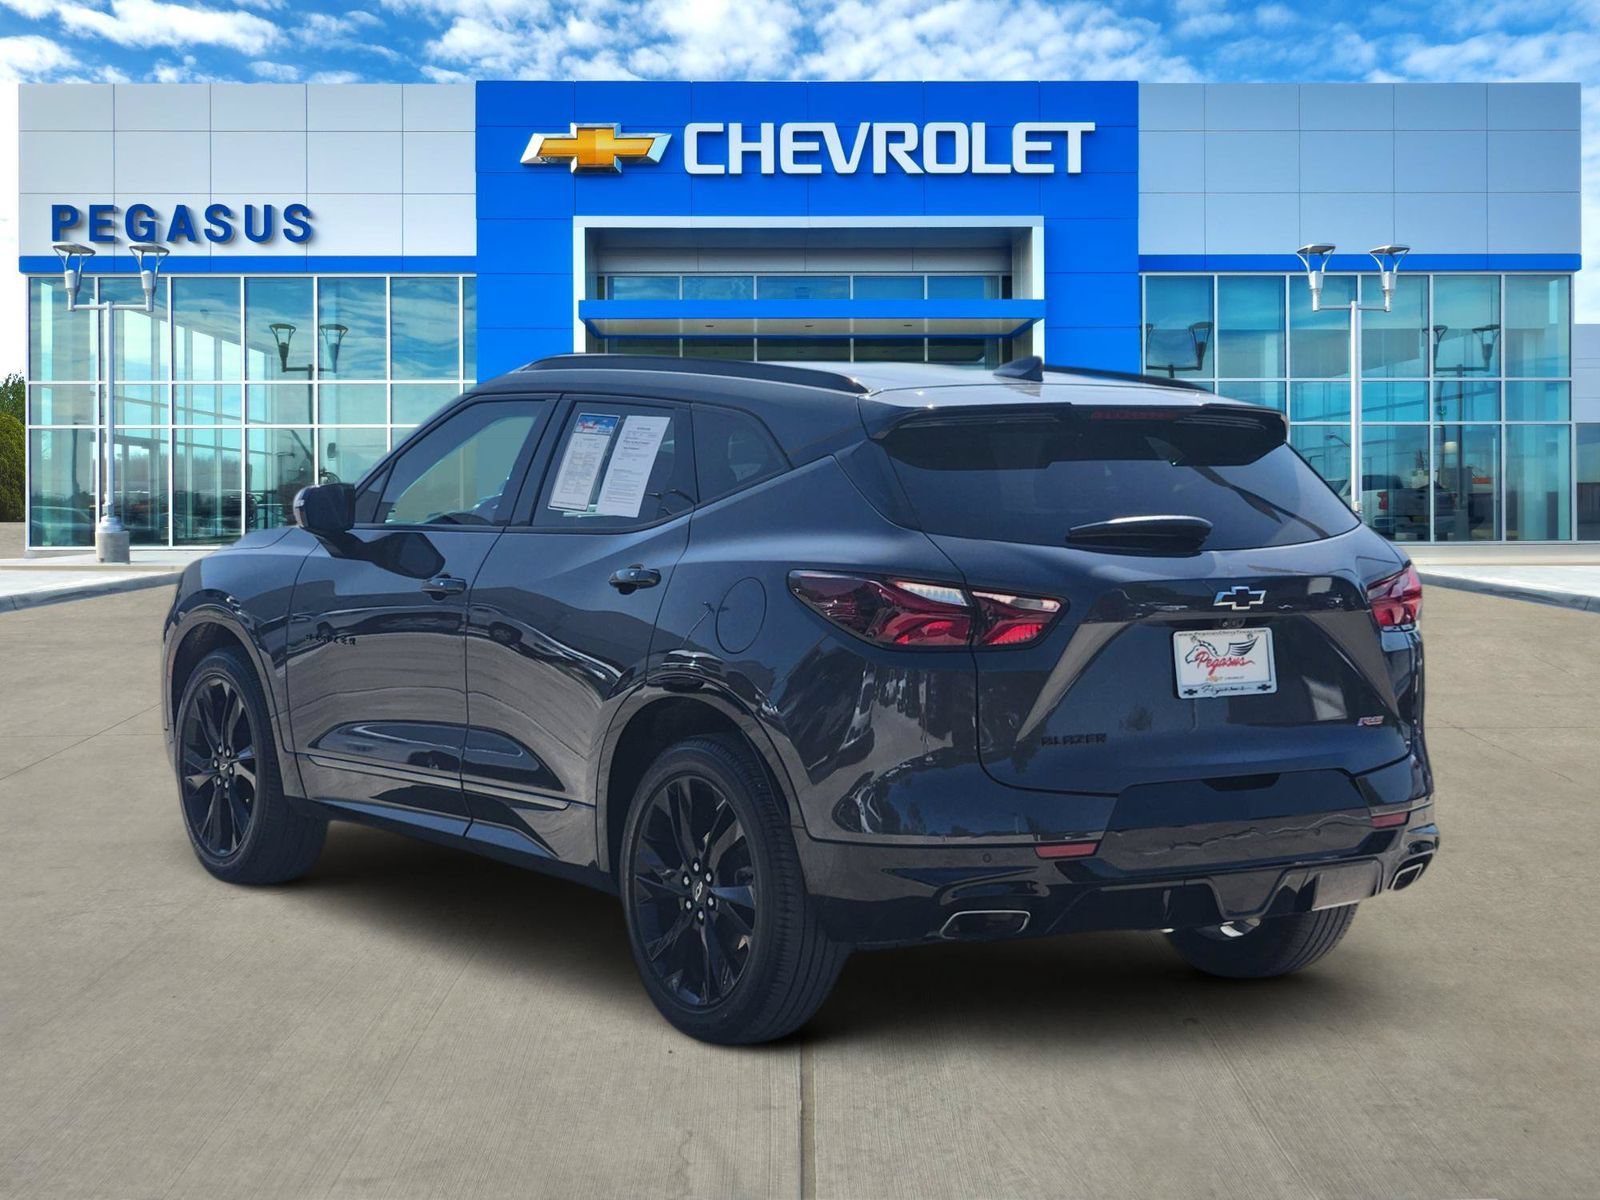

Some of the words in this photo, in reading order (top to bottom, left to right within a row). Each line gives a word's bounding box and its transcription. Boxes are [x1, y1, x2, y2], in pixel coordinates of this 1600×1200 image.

[684, 122, 1096, 175] CHEVROLET
[51, 204, 313, 243] PEGASUS
[1195, 651, 1255, 676] Pegasus
[1357, 715, 1384, 727] RS
[1040, 733, 1107, 747] BLAZER
